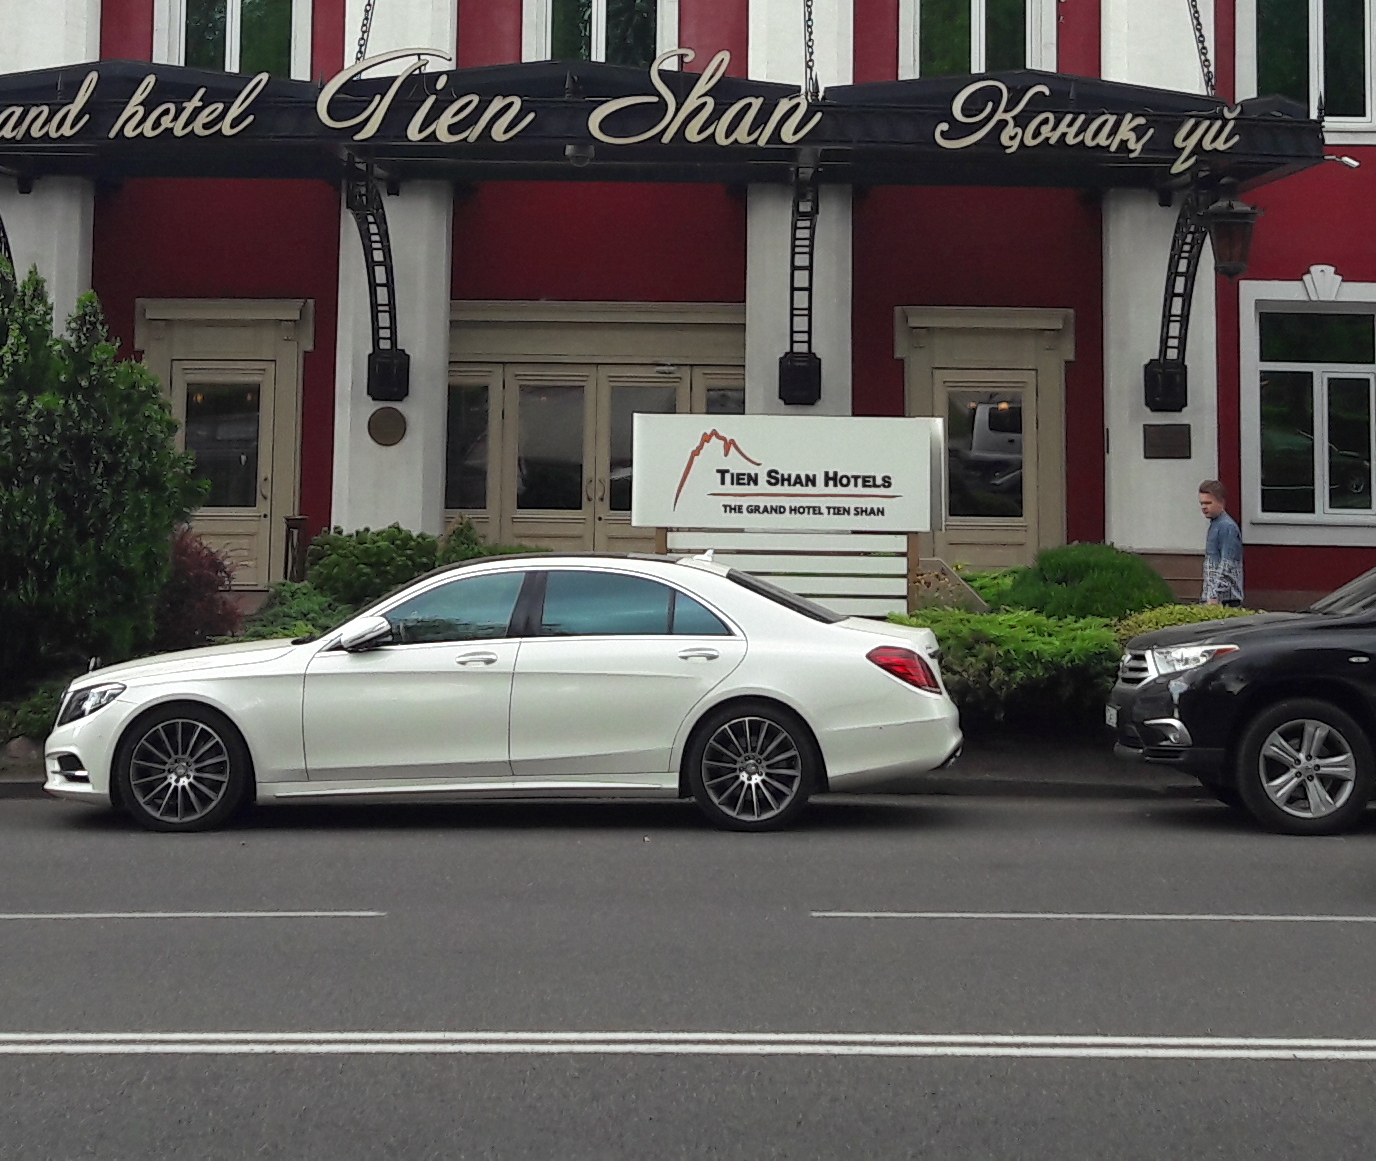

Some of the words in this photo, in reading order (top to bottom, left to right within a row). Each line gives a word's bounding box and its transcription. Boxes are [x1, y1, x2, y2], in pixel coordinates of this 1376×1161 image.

[108, 70, 270, 140] hotel
[316, 47, 536, 143] Tien
[587, 47, 823, 147] Shan
[722, 503, 743, 515] THE
[745, 504, 786, 516] GRAND
[788, 505, 824, 517] HOTEL
[825, 506, 851, 517] TIEN
[853, 506, 885, 518] SHAN
